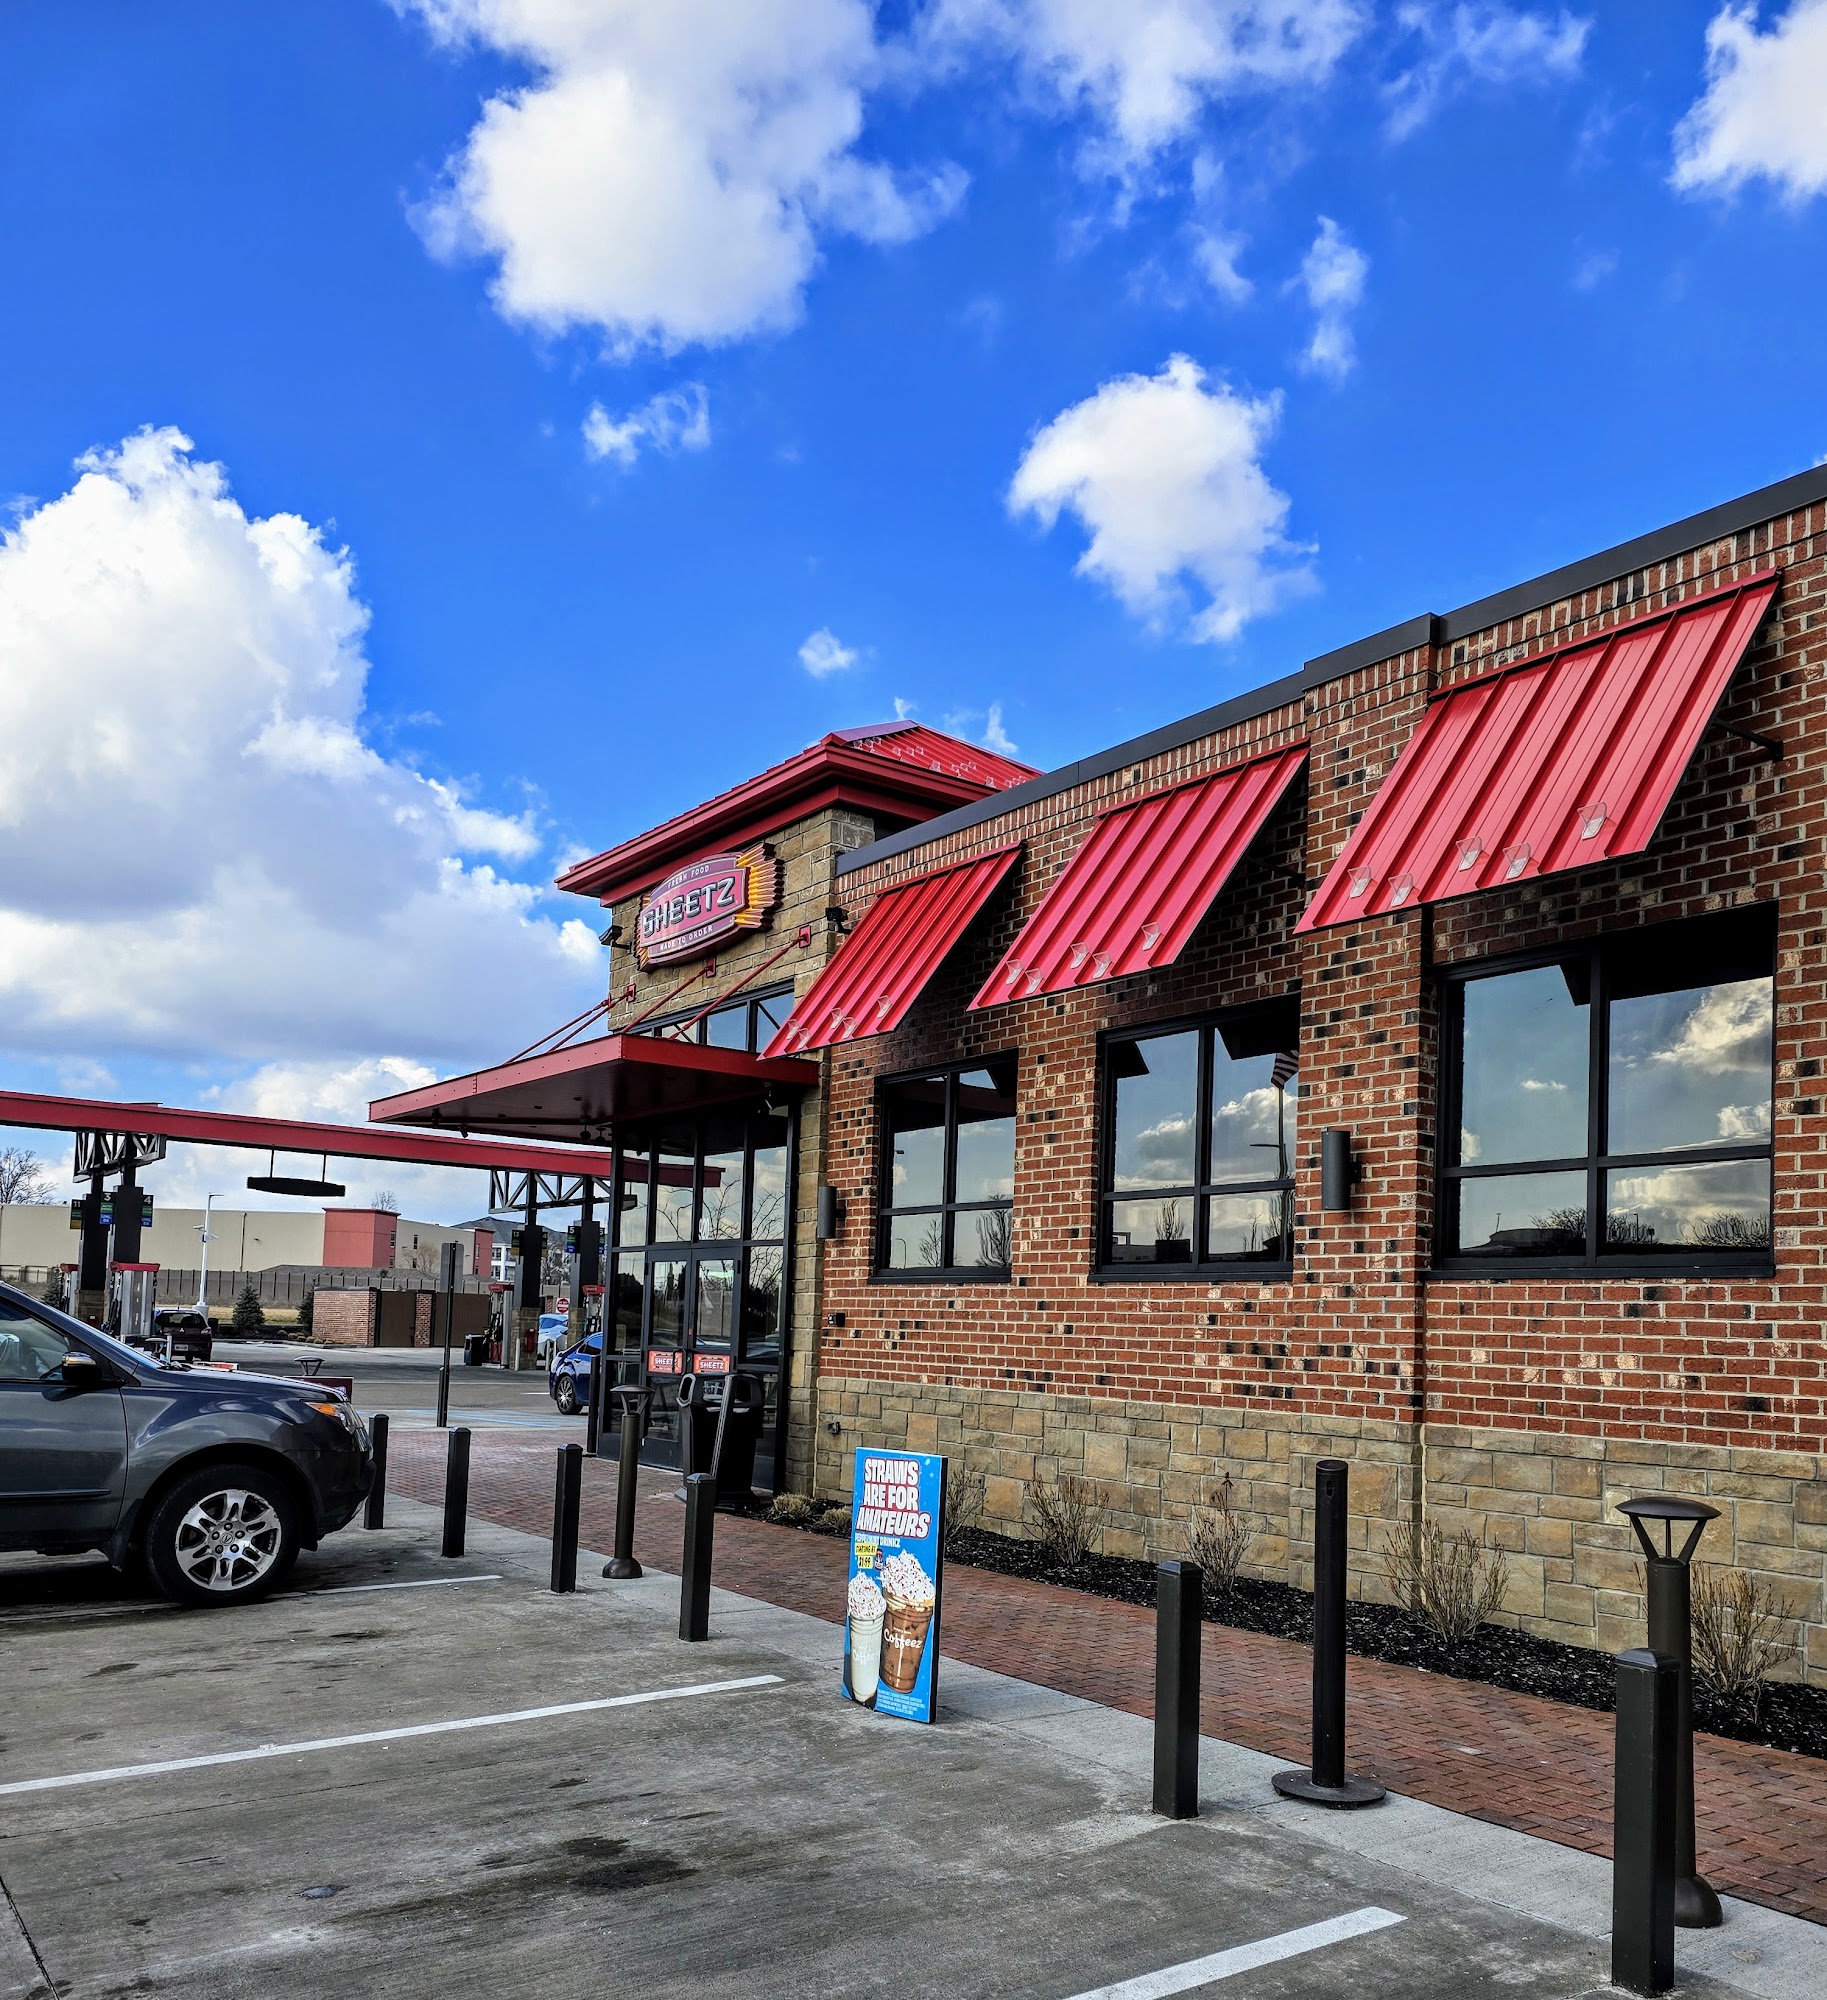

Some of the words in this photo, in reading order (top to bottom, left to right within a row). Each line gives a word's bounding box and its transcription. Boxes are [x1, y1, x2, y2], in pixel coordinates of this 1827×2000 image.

[667, 873, 689, 890] FRESH
[691, 865, 710, 878] FOOD
[643, 876, 735, 938] SHEETZ
[660, 942, 675, 951] MADE
[678, 936, 686, 944] TO
[689, 925, 713, 940] ORDER
[104, 1193, 112, 1201] 3
[144, 1196, 152, 1205] 4
[700, 1361, 724, 1370] SHEETZ
[864, 1458, 919, 1486] STRAWS
[863, 1483, 886, 1508] ARE
[887, 1485, 919, 1511] FOR
[856, 1507, 931, 1538] AMATEURS
[884, 1628, 923, 1649] Coffeez
